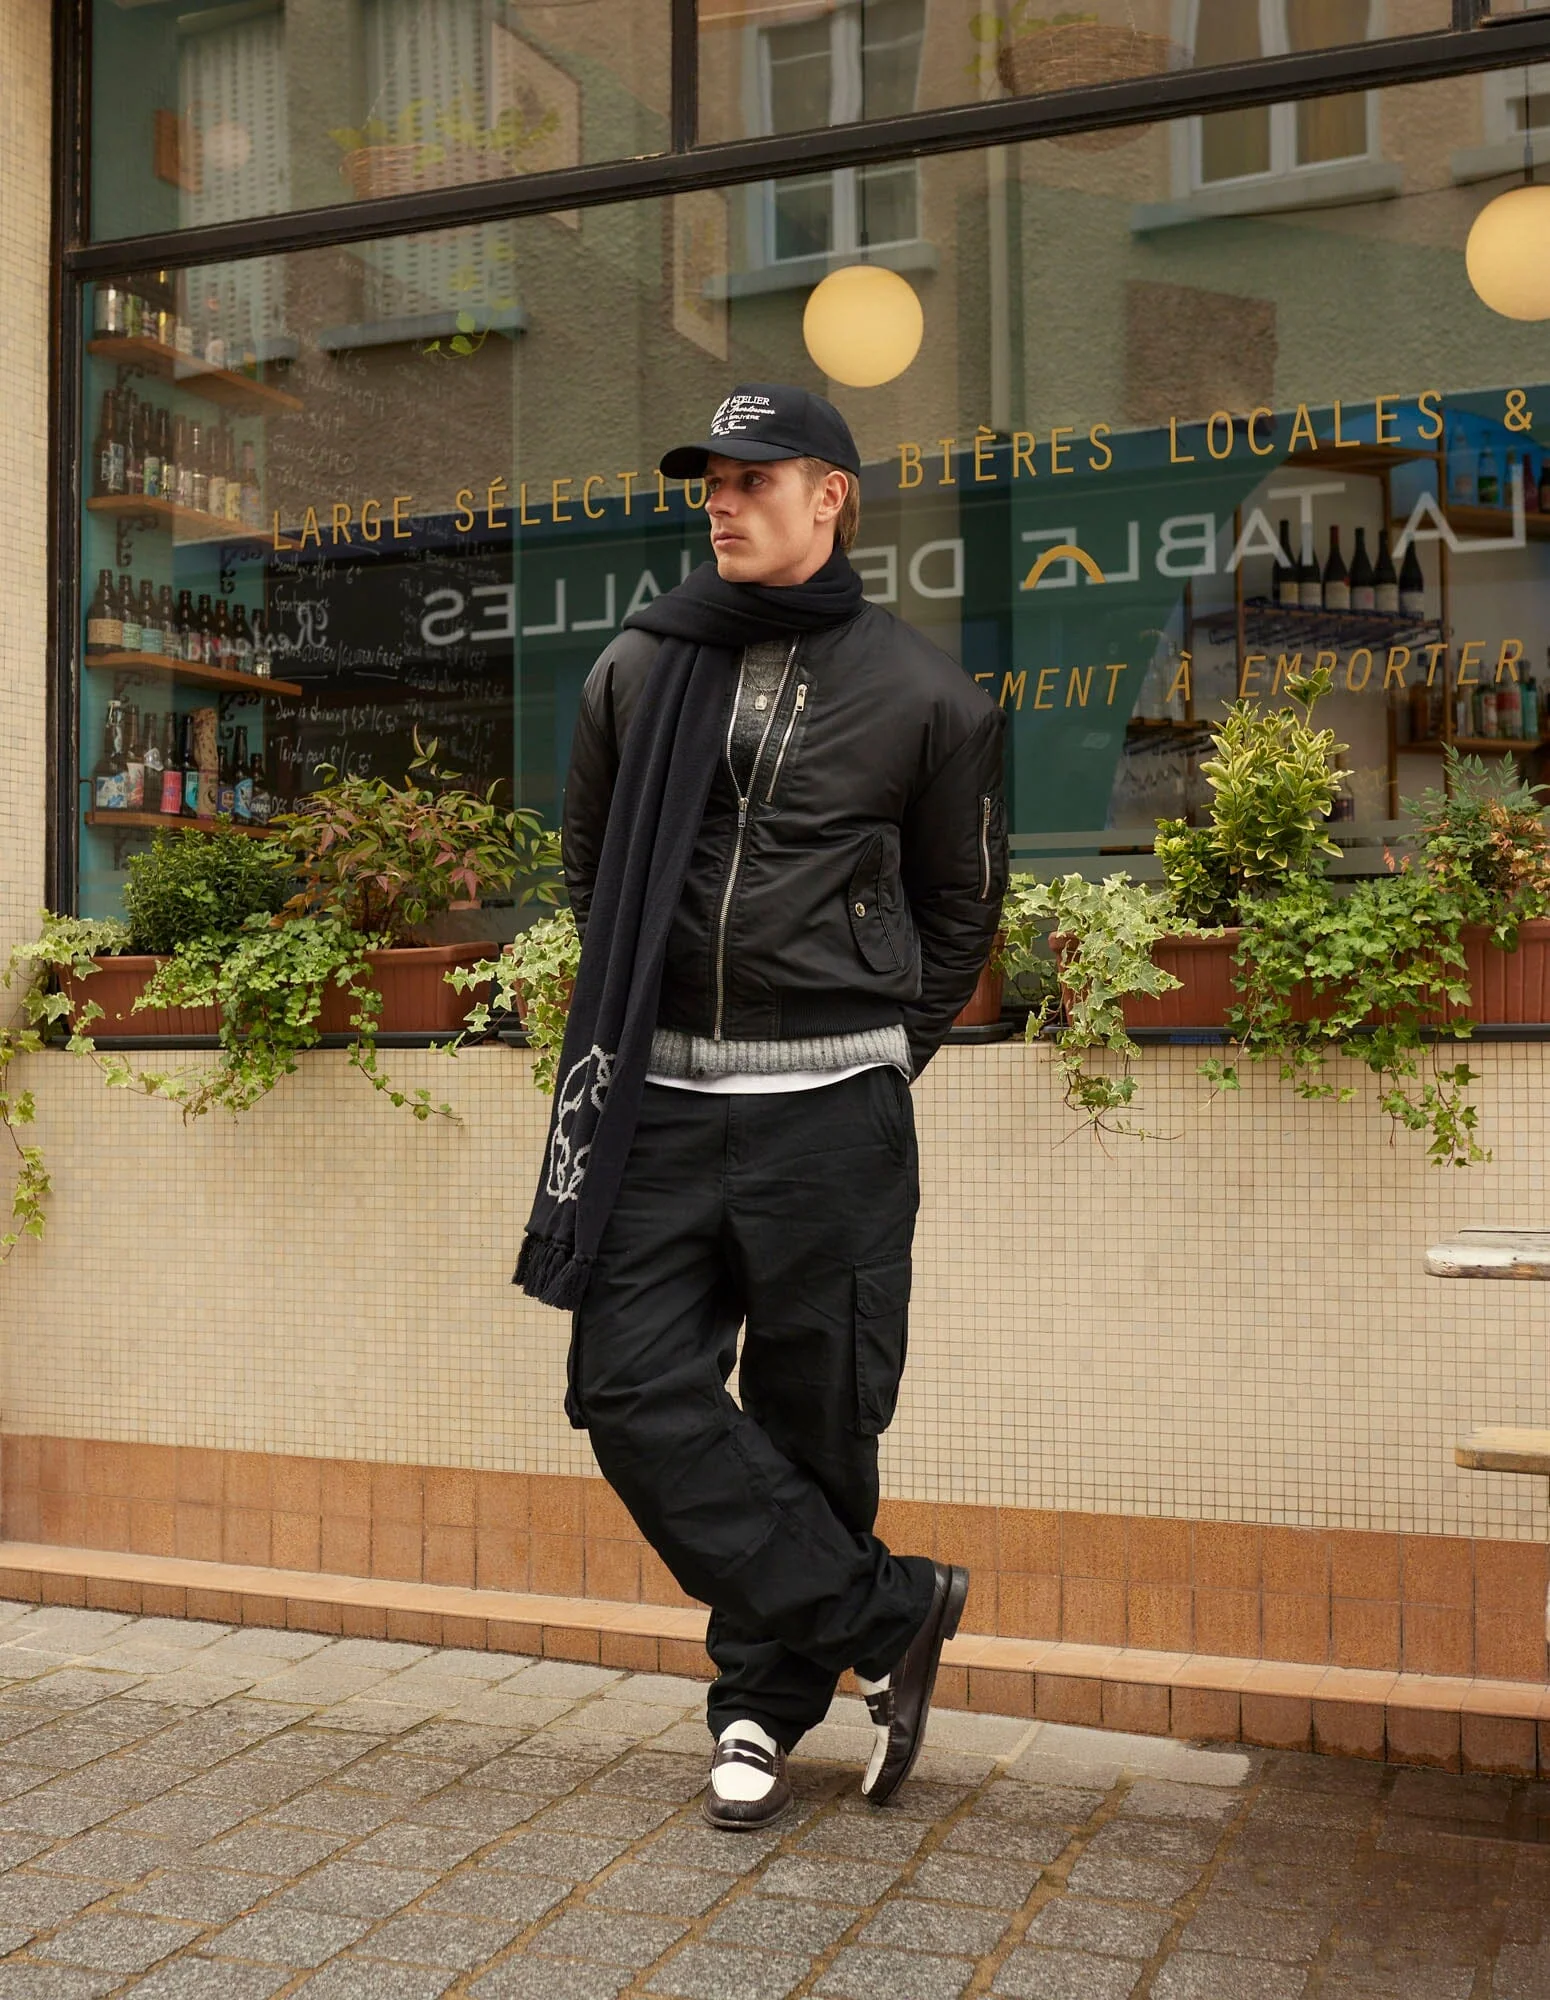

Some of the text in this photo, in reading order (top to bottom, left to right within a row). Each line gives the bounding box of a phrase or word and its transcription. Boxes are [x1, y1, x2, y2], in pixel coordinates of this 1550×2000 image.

[273, 388, 1533, 551] LARGE SÉLECTIO BIÈRES LOCALES &
[1166, 651, 1194, 701] À
[1239, 638, 1525, 698] EMPORTER
